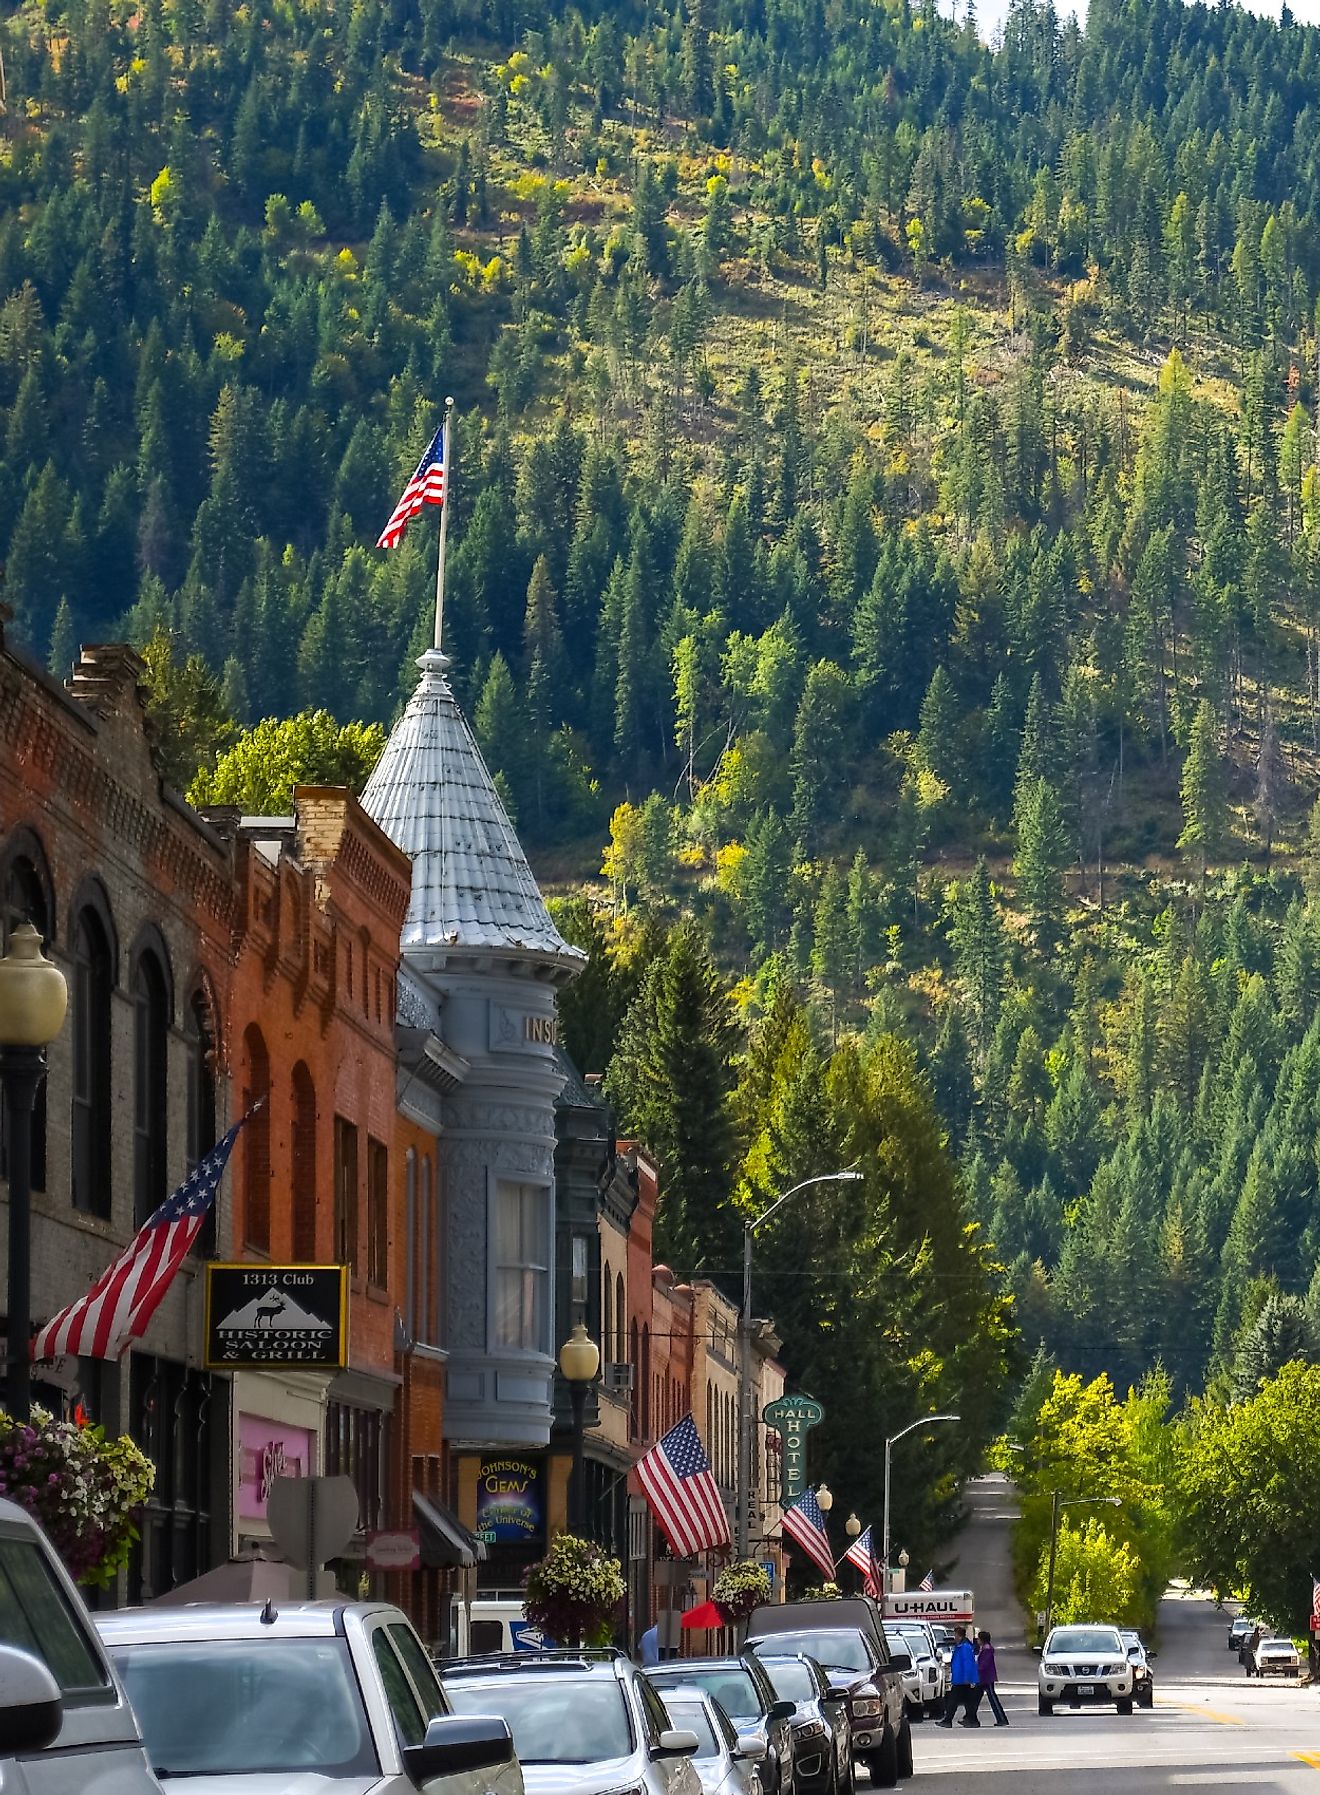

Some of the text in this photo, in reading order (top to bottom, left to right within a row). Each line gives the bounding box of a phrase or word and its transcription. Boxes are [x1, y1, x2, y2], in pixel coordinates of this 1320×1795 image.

[242, 1274, 315, 1286] 1313 Club
[218, 1330, 333, 1340] HISTORIC
[225, 1340, 322, 1350] SALOON
[222, 1351, 326, 1360] & GRILL
[774, 1409, 816, 1419] HALL
[786, 1420, 801, 1497] HOTEL
[747, 1491, 757, 1529] REAL
[495, 1515, 535, 1533] Universe
[894, 1602, 958, 1613] U-HAUL
